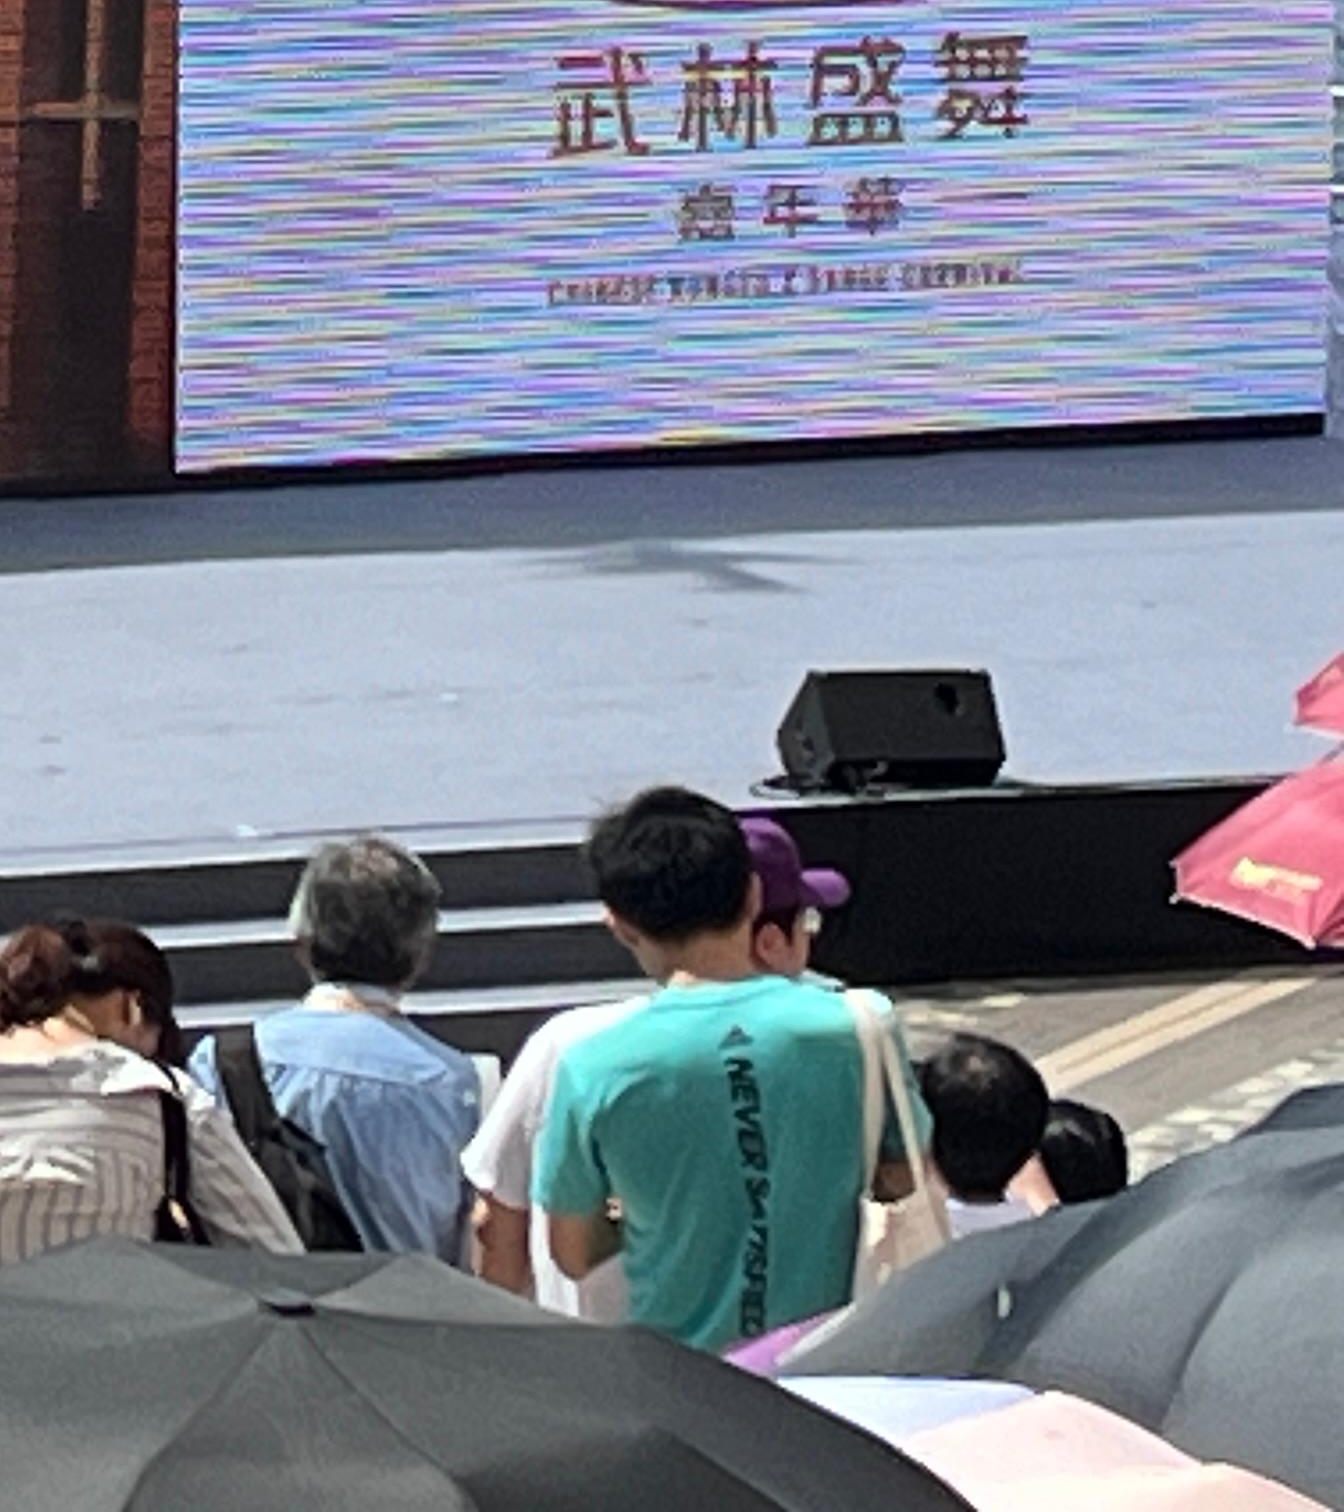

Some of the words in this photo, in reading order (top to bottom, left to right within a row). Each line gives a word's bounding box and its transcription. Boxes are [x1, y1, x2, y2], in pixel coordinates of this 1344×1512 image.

[547, 32, 1029, 159] 武林盛舞
[724, 1057, 769, 1172] NEVER
